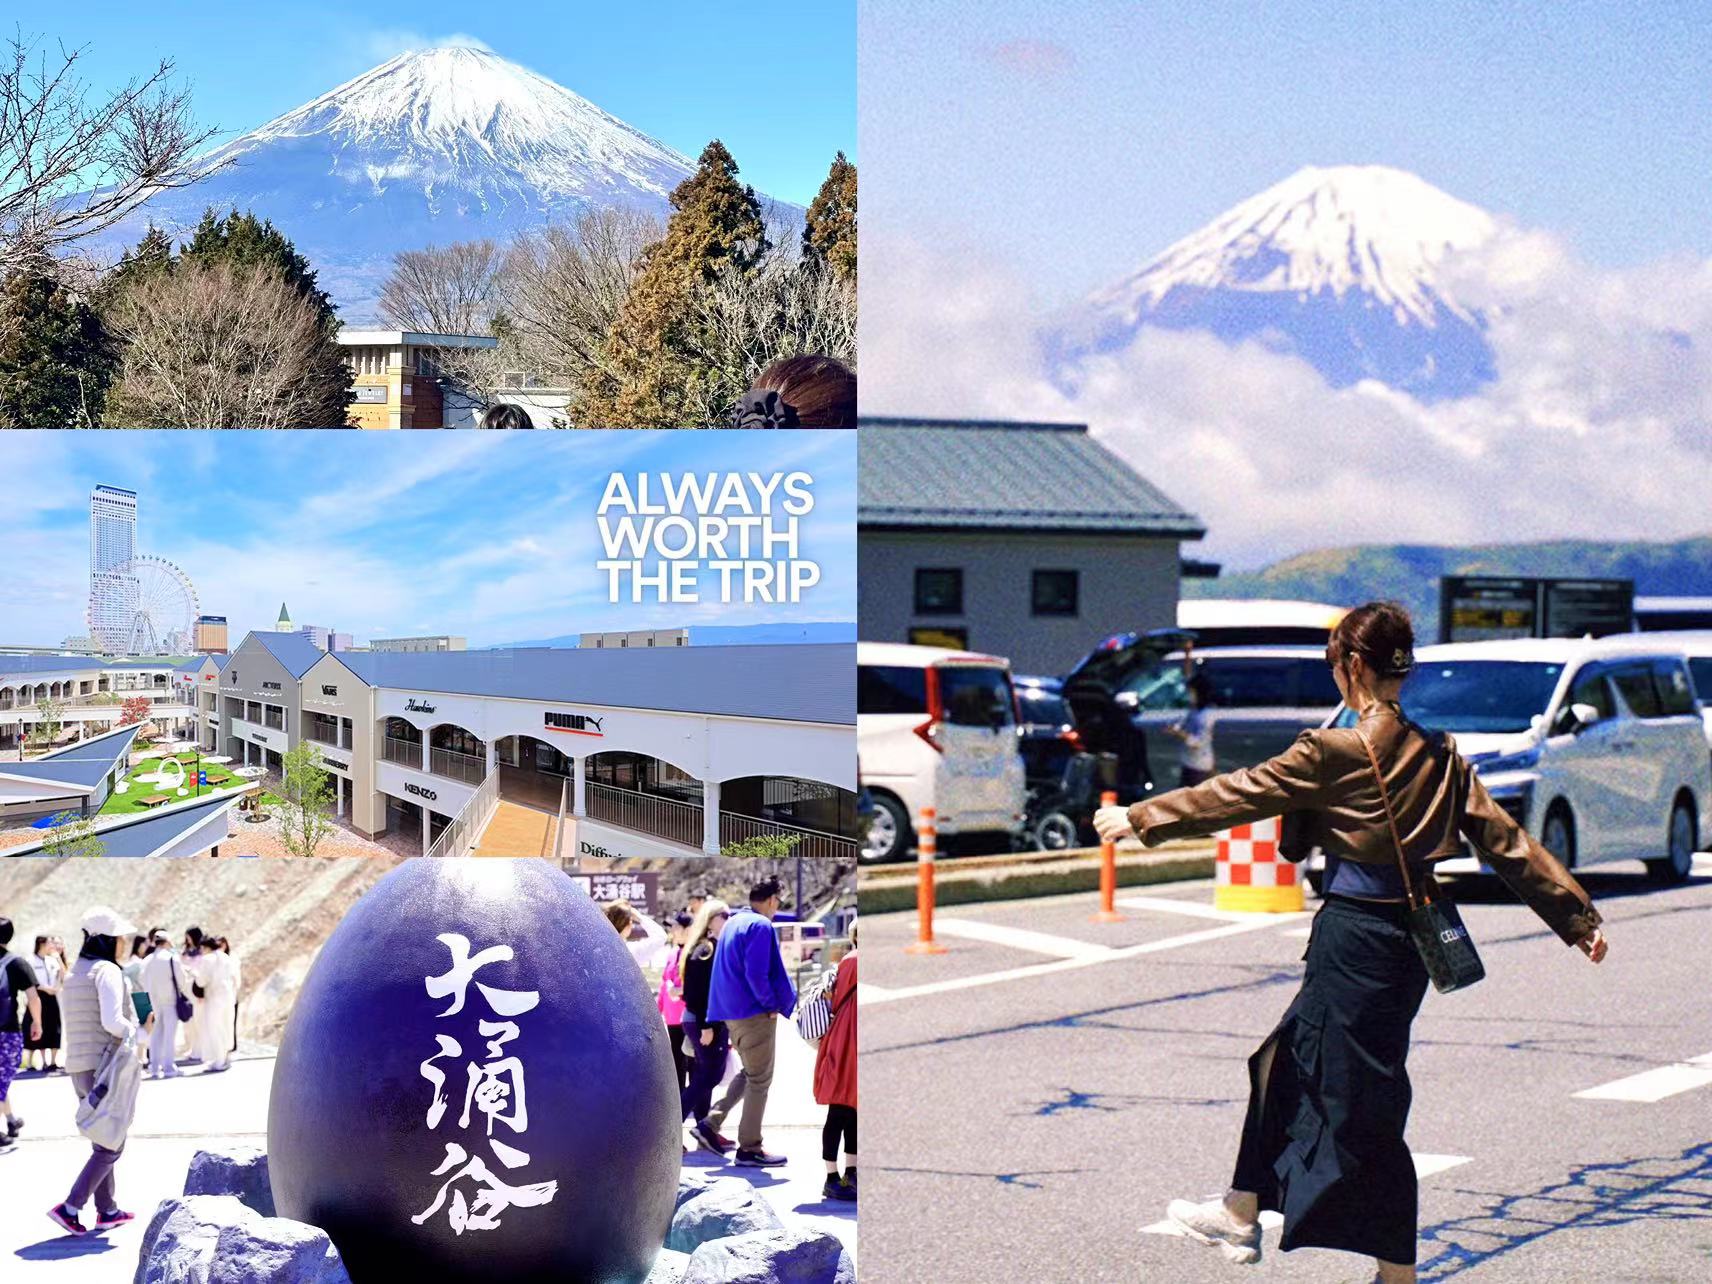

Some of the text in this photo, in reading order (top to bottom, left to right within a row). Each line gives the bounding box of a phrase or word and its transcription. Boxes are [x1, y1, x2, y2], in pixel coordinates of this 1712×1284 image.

[544, 711, 585, 730] PUMA
[404, 782, 437, 801] KENZO
[411, 932, 559, 1236] 大涌谷
